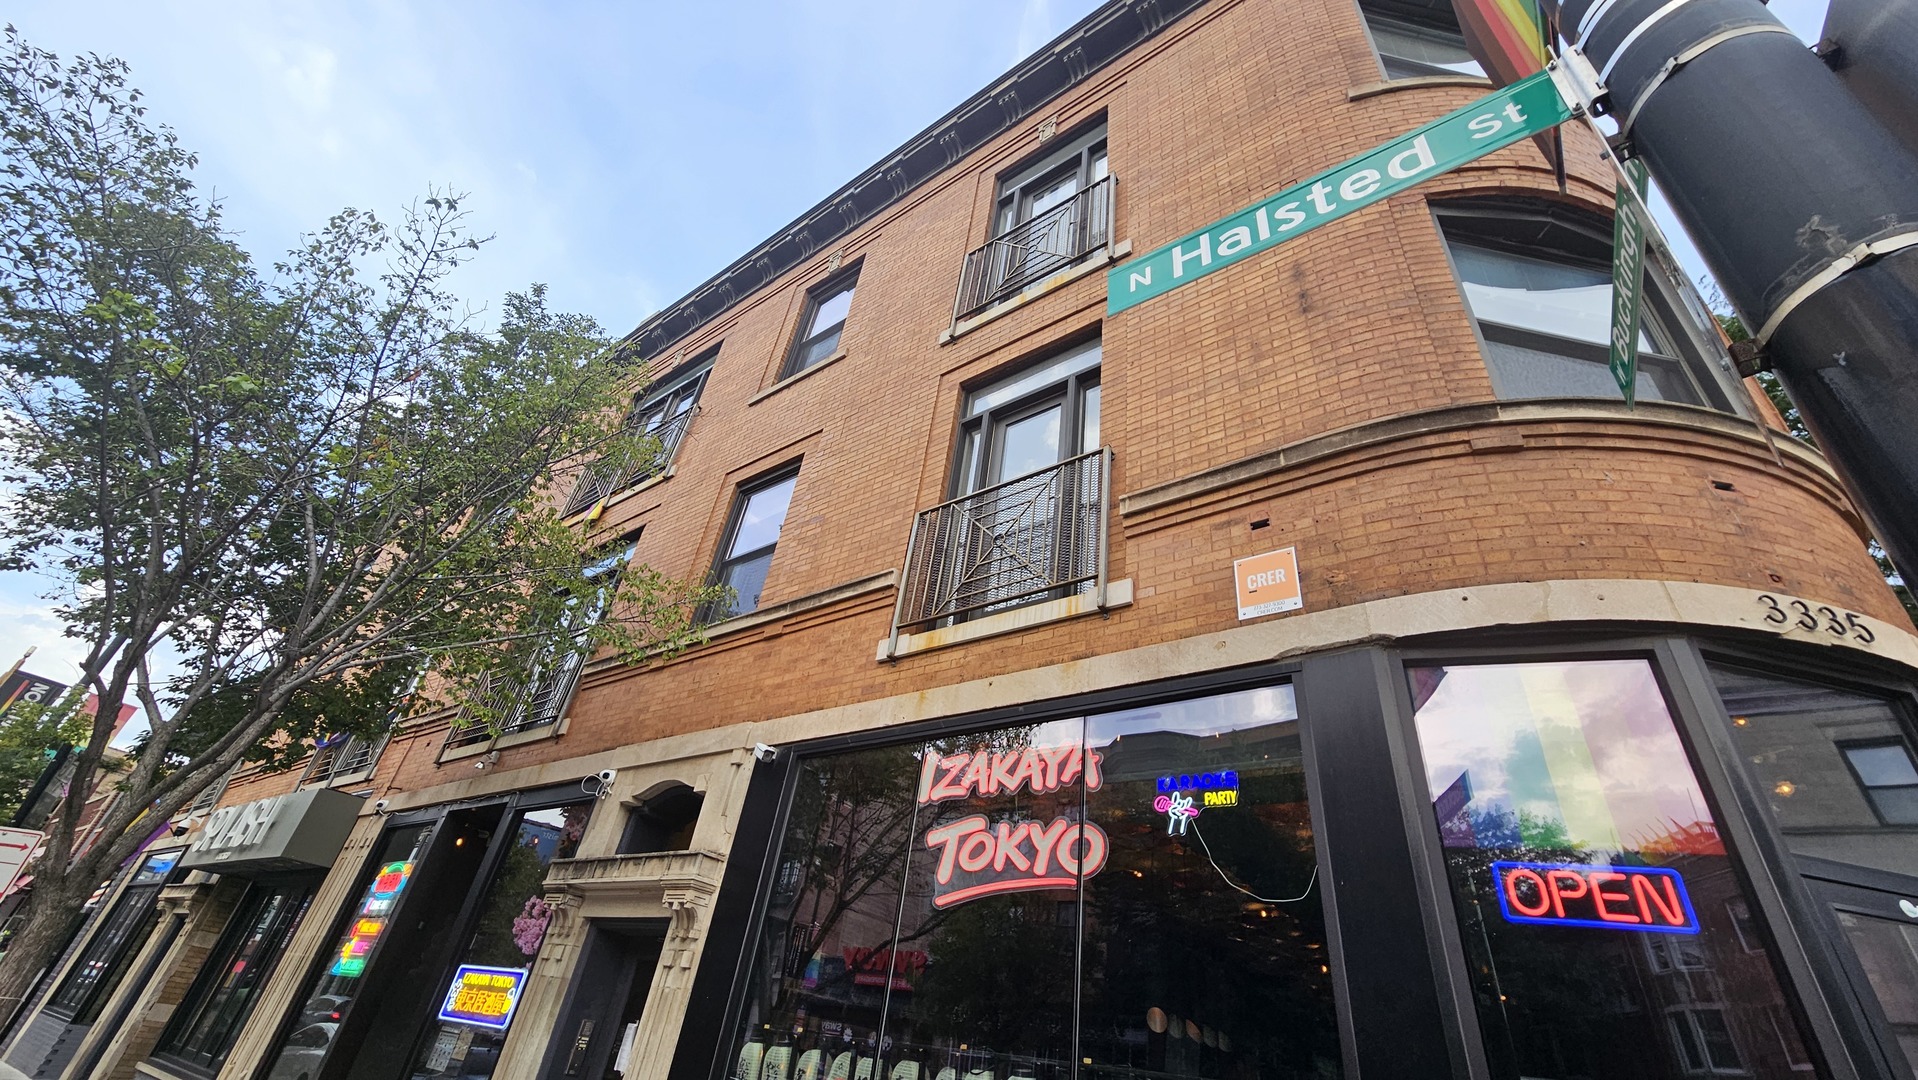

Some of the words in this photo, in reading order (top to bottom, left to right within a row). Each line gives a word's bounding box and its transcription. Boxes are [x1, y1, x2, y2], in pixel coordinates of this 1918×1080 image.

[1129, 265, 1152, 293] N
[1171, 134, 1437, 279] Halsted
[1467, 102, 1528, 139] St
[1612, 157, 1642, 363] Buckinghm
[1246, 568, 1286, 590] CRER
[1758, 594, 1876, 644] 3335
[918, 740, 1100, 803] IZAKAYA
[1157, 769, 1237, 792] KARAOKE
[1204, 790, 1237, 806] PARTY
[192, 795, 286, 852] SPLASH
[926, 817, 1106, 885] TOKYO
[1506, 868, 1685, 926] OPEN
[463, 972, 492, 986] IZAKAYA
[491, 974, 515, 988] TOKYO
